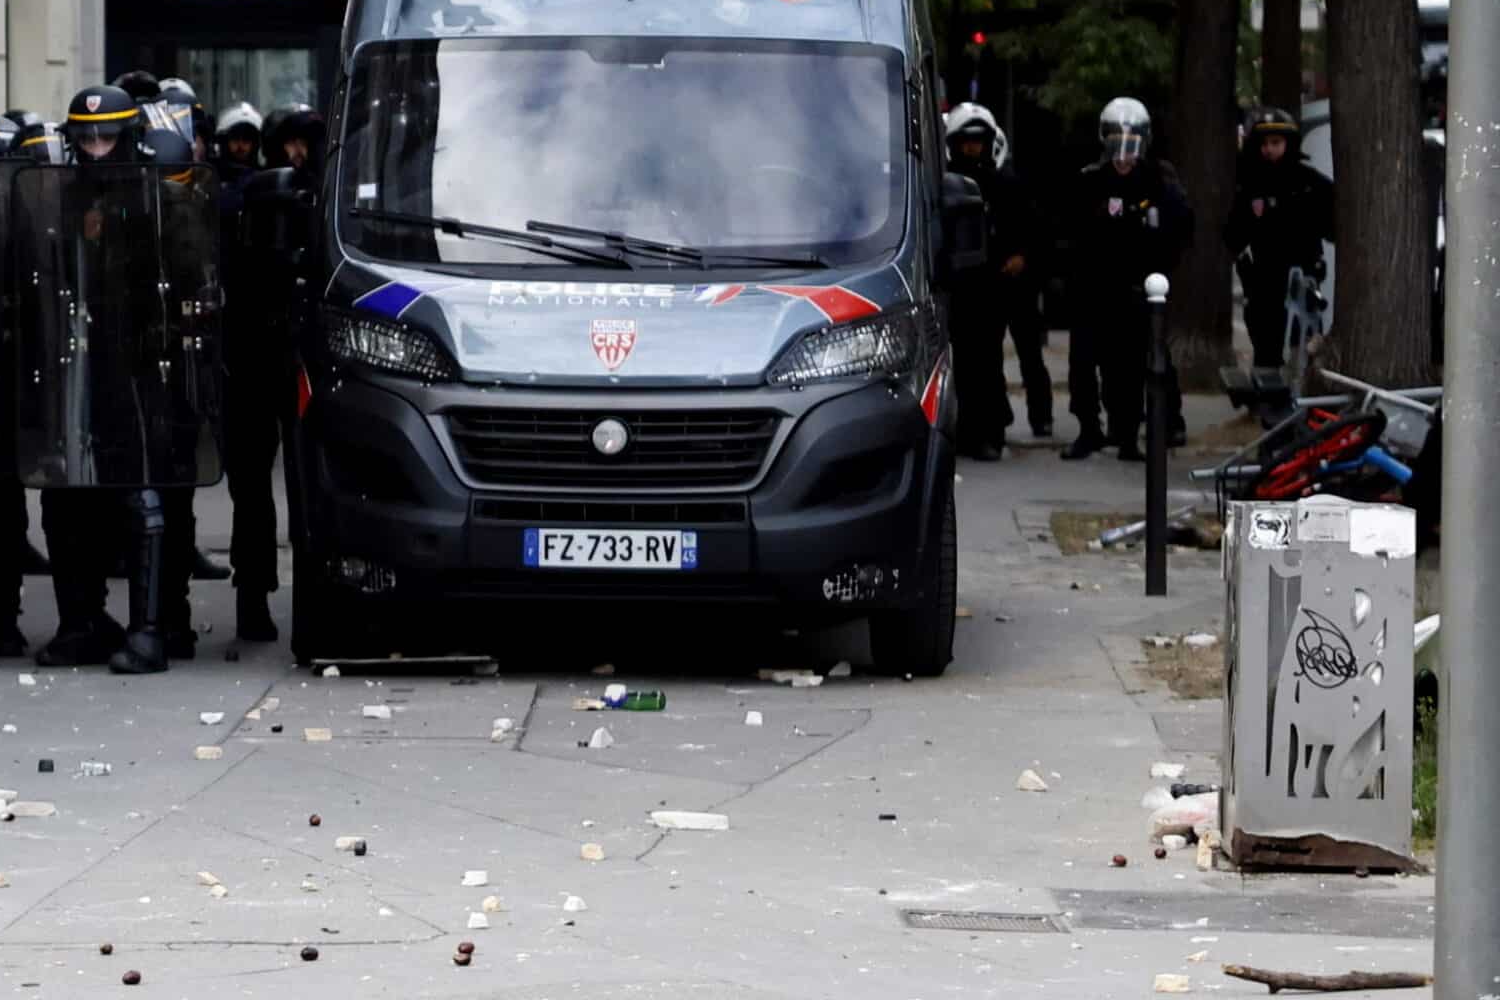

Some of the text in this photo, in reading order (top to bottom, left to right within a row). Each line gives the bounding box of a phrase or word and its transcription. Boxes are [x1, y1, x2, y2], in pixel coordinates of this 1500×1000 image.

[488, 281, 676, 297] POLICE
[487, 296, 673, 308] NATIONALE
[594, 334, 632, 348] CRS
[543, 534, 676, 563] FZ-733-RV
[682, 549, 697, 563] 45
